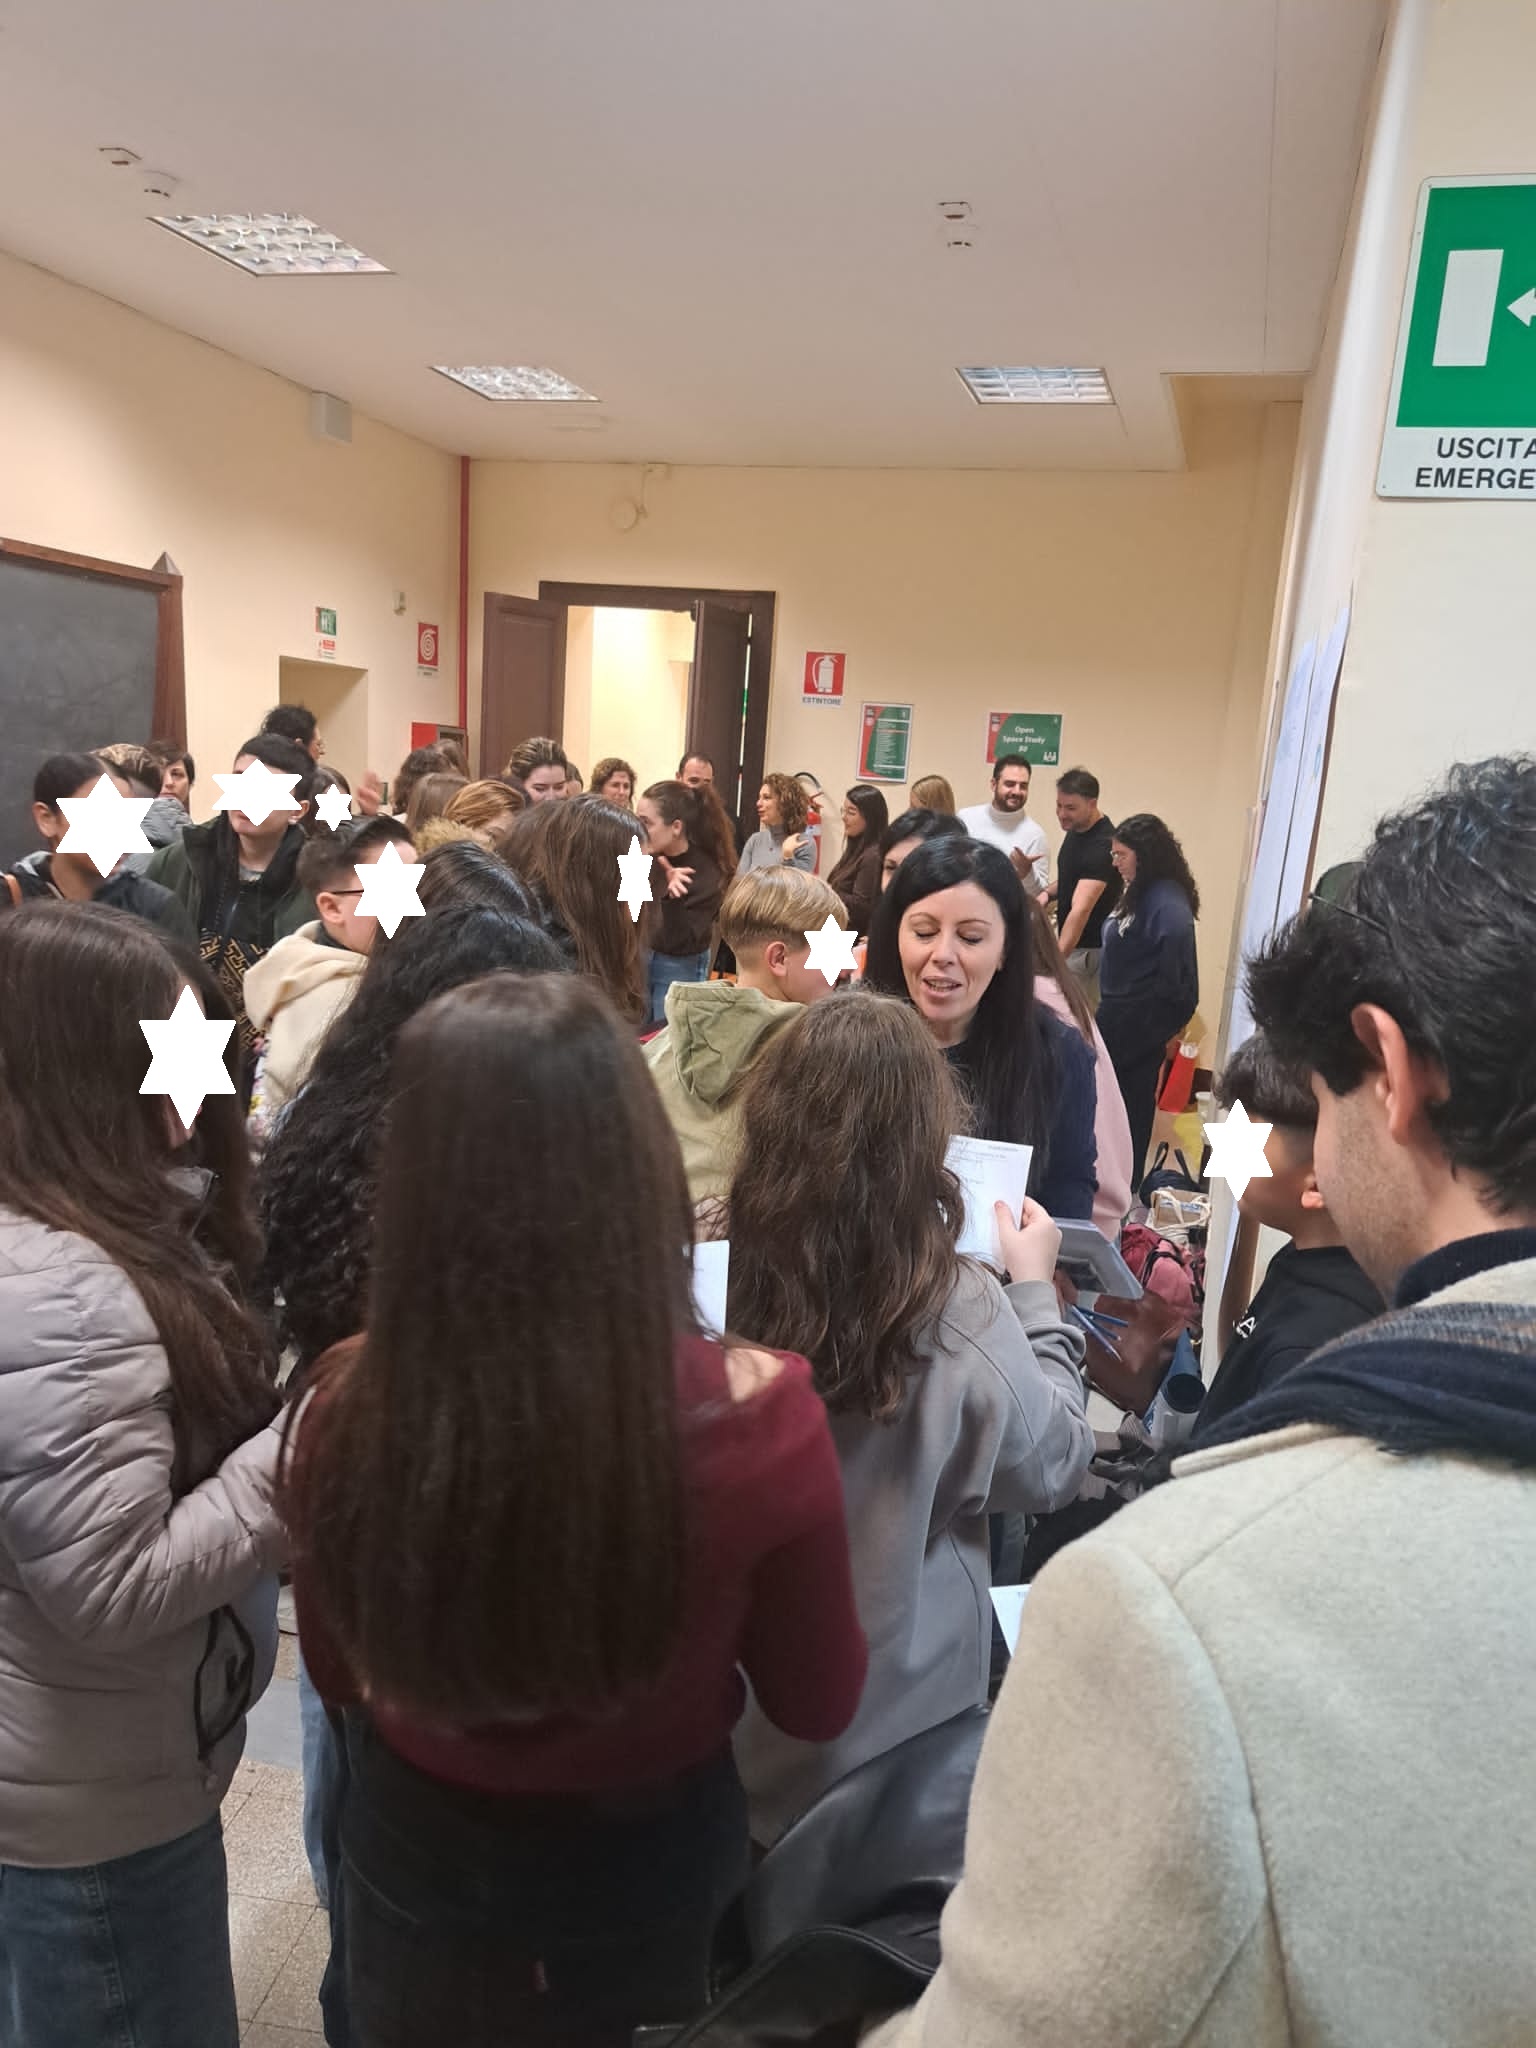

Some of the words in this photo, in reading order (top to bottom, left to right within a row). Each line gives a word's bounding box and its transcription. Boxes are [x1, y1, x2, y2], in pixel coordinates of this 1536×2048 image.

[1415, 467, 1536, 489] EMERGE
[802, 697, 841, 705] ESTINTORE
[1014, 726, 1035, 735] Open
[1025, 736, 1046, 745] Study
